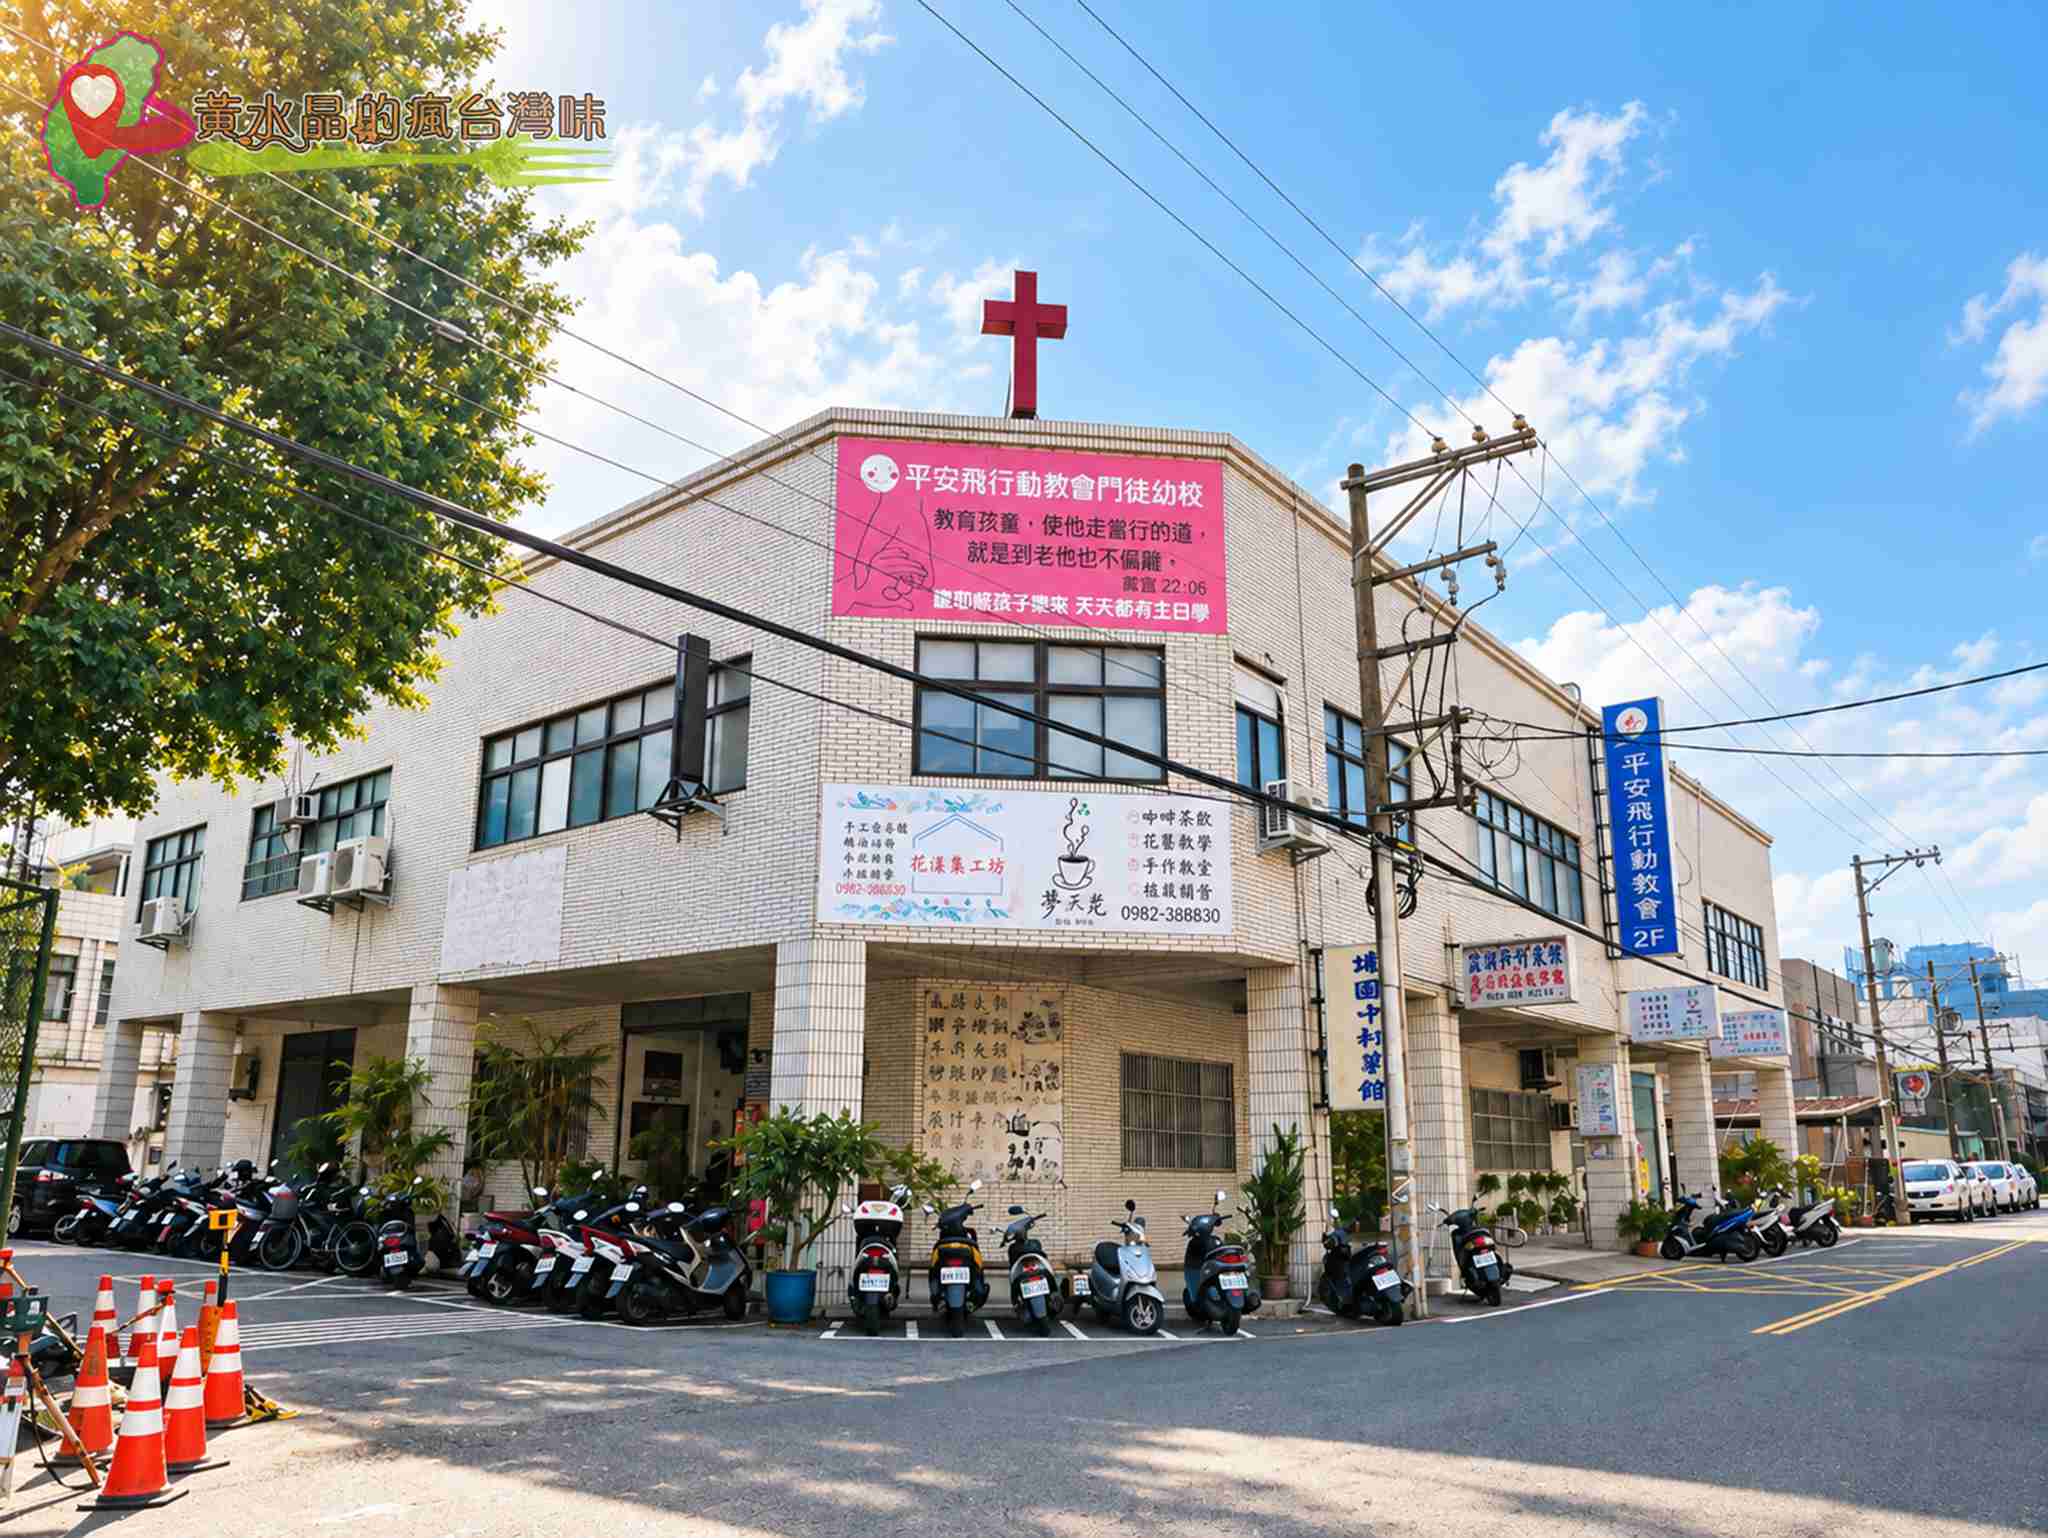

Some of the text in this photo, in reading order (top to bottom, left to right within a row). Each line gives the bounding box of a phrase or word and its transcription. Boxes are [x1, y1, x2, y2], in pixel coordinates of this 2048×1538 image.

[905, 463, 1203, 508] 平安飛行動教會門徒幼校
[1162, 578, 1207, 596] 22:06
[1622, 752, 1662, 921] 平安飛行動教會
[1121, 904, 1221, 924] 0982-388830
[1633, 928, 1665, 949] 2F
